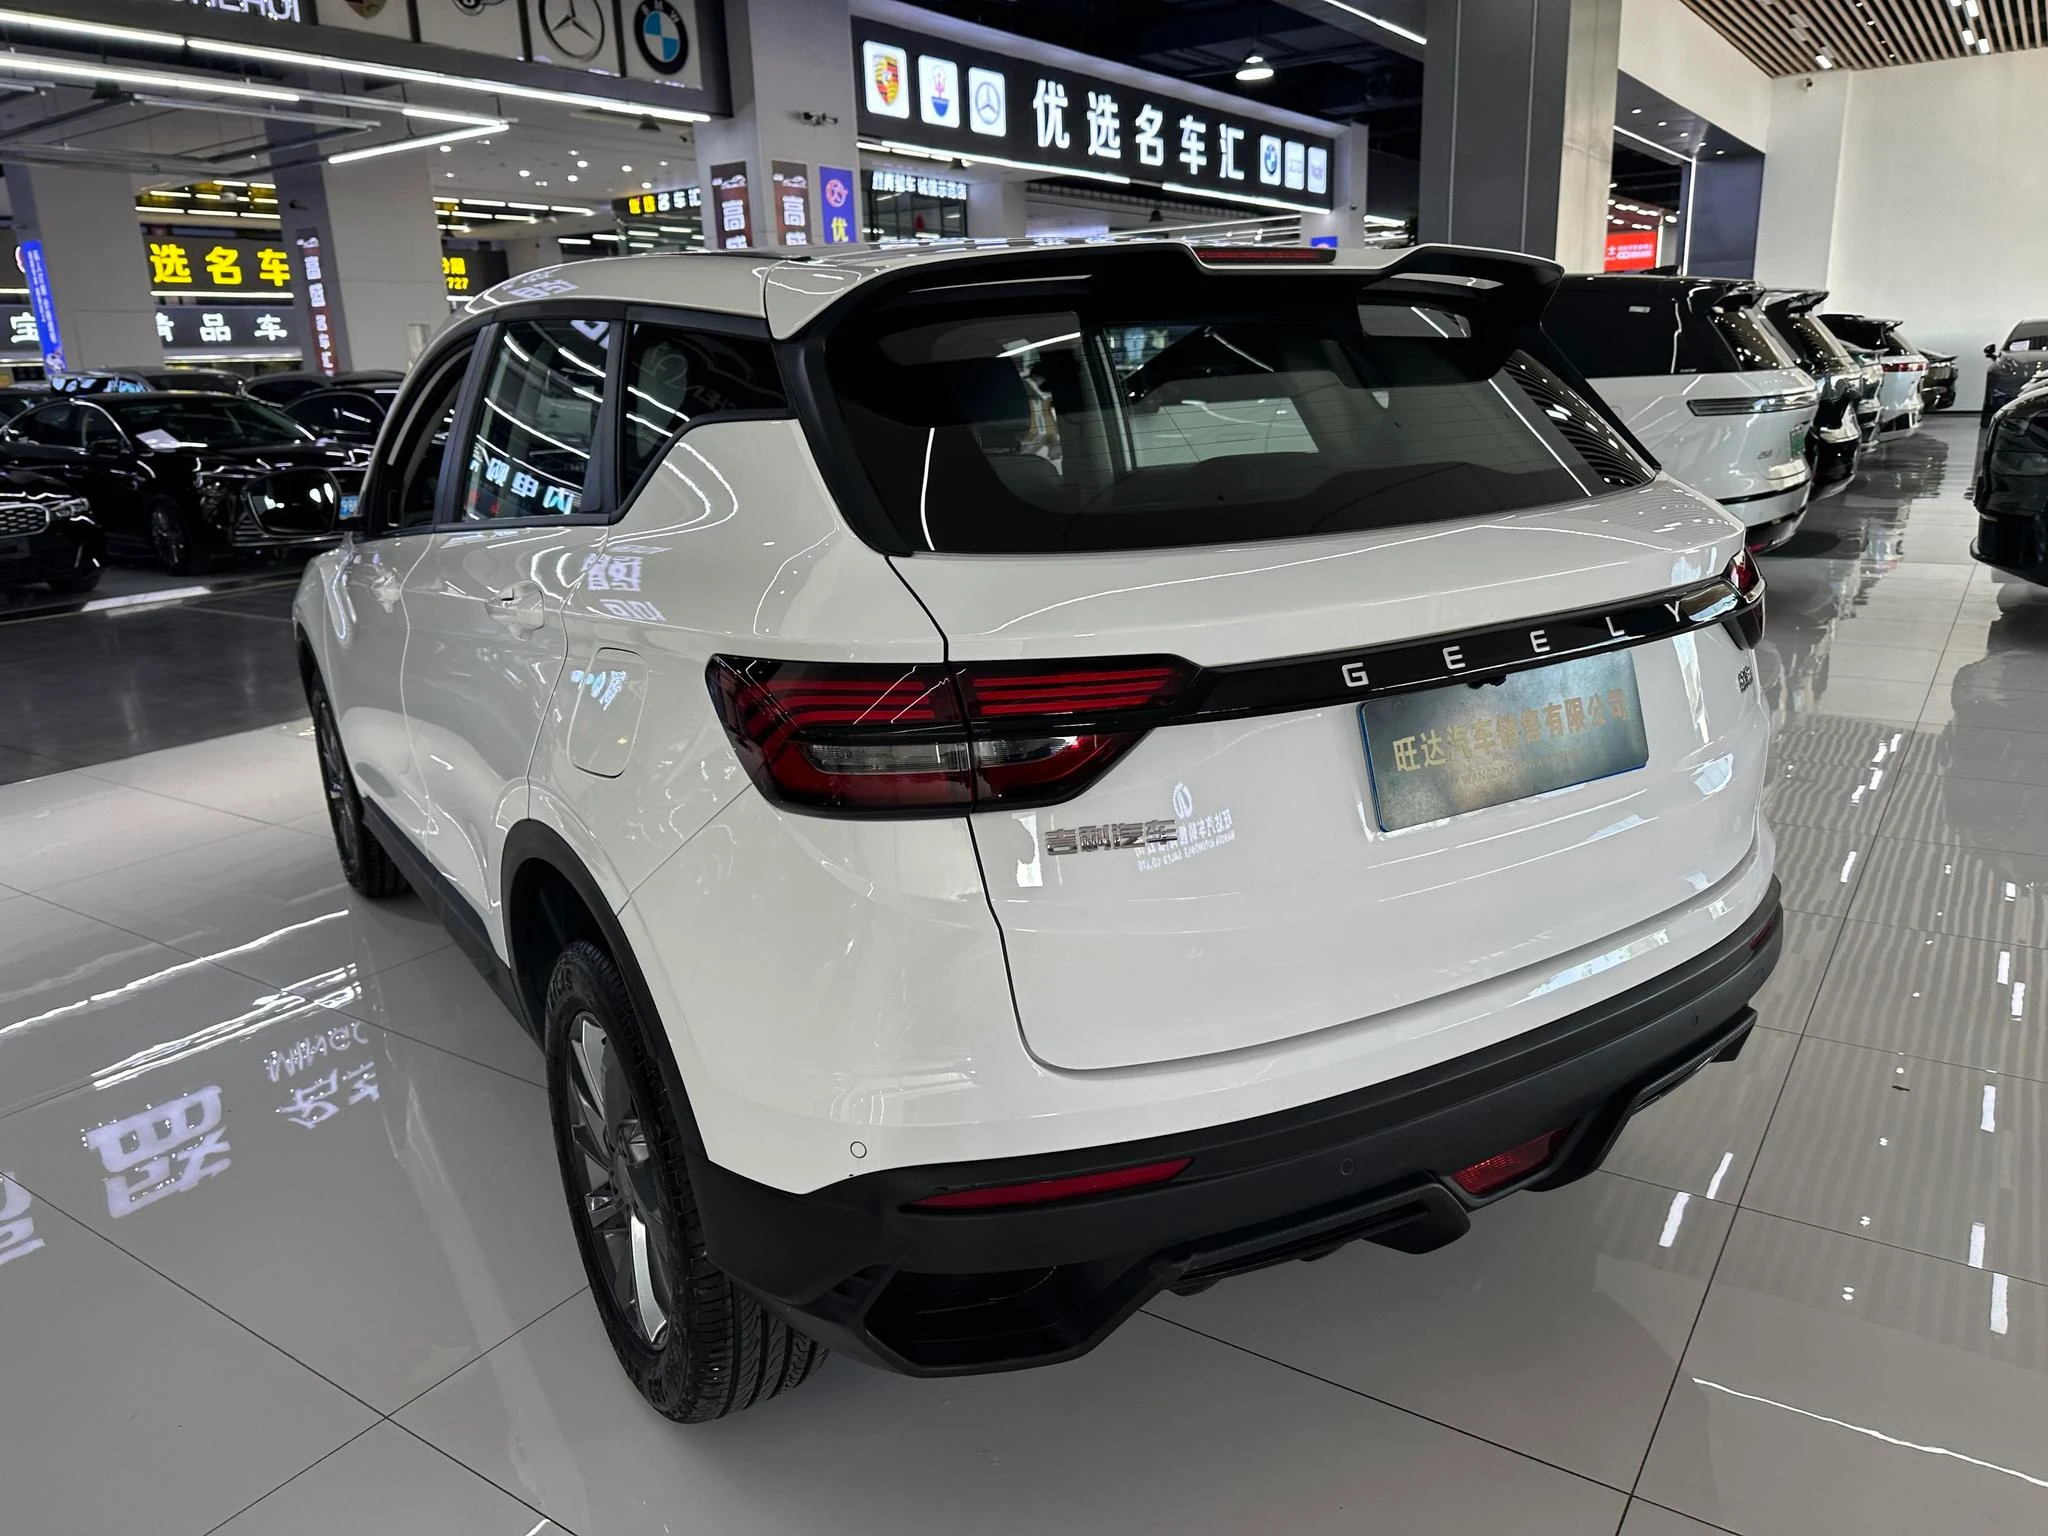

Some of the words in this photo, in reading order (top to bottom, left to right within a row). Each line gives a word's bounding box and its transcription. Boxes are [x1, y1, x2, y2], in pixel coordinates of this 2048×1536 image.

[1033, 77, 1245, 181] 优选名车汇
[148, 243, 291, 287] 选名车
[1341, 600, 1685, 688] GEELY
[1393, 688, 1627, 773] 旺达汽车销售有限公司
[1045, 819, 1178, 856] 吉利汽车
